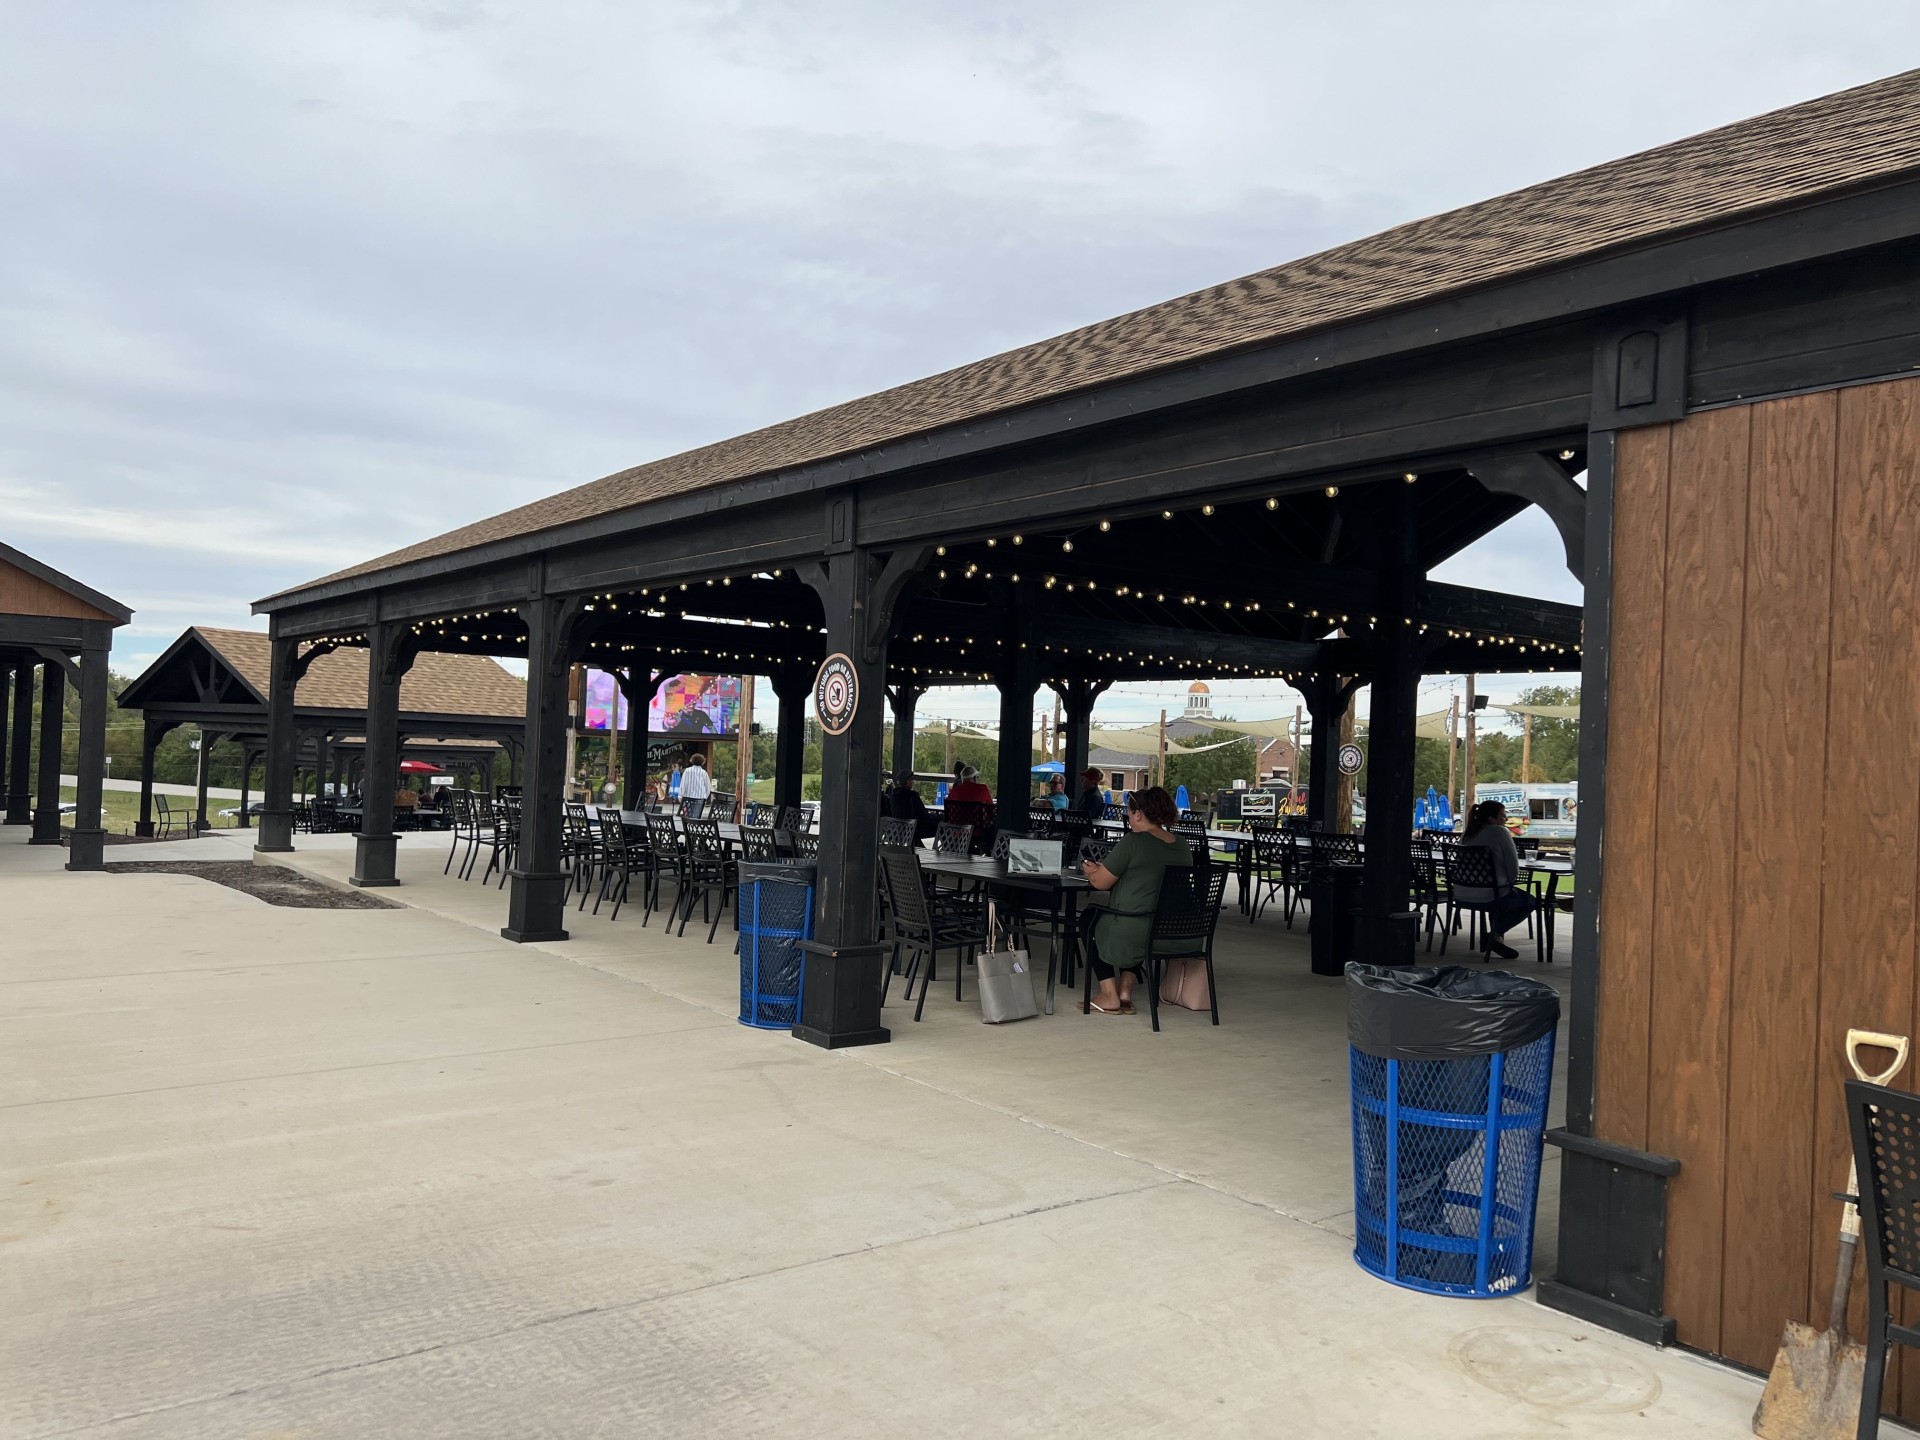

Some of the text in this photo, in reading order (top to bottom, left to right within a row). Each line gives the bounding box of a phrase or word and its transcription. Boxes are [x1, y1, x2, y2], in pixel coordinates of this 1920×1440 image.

[819, 671, 829, 699] OUTSIDE
[828, 663, 840, 673] FOOD
[845, 671, 853, 711] BEVERAGES
